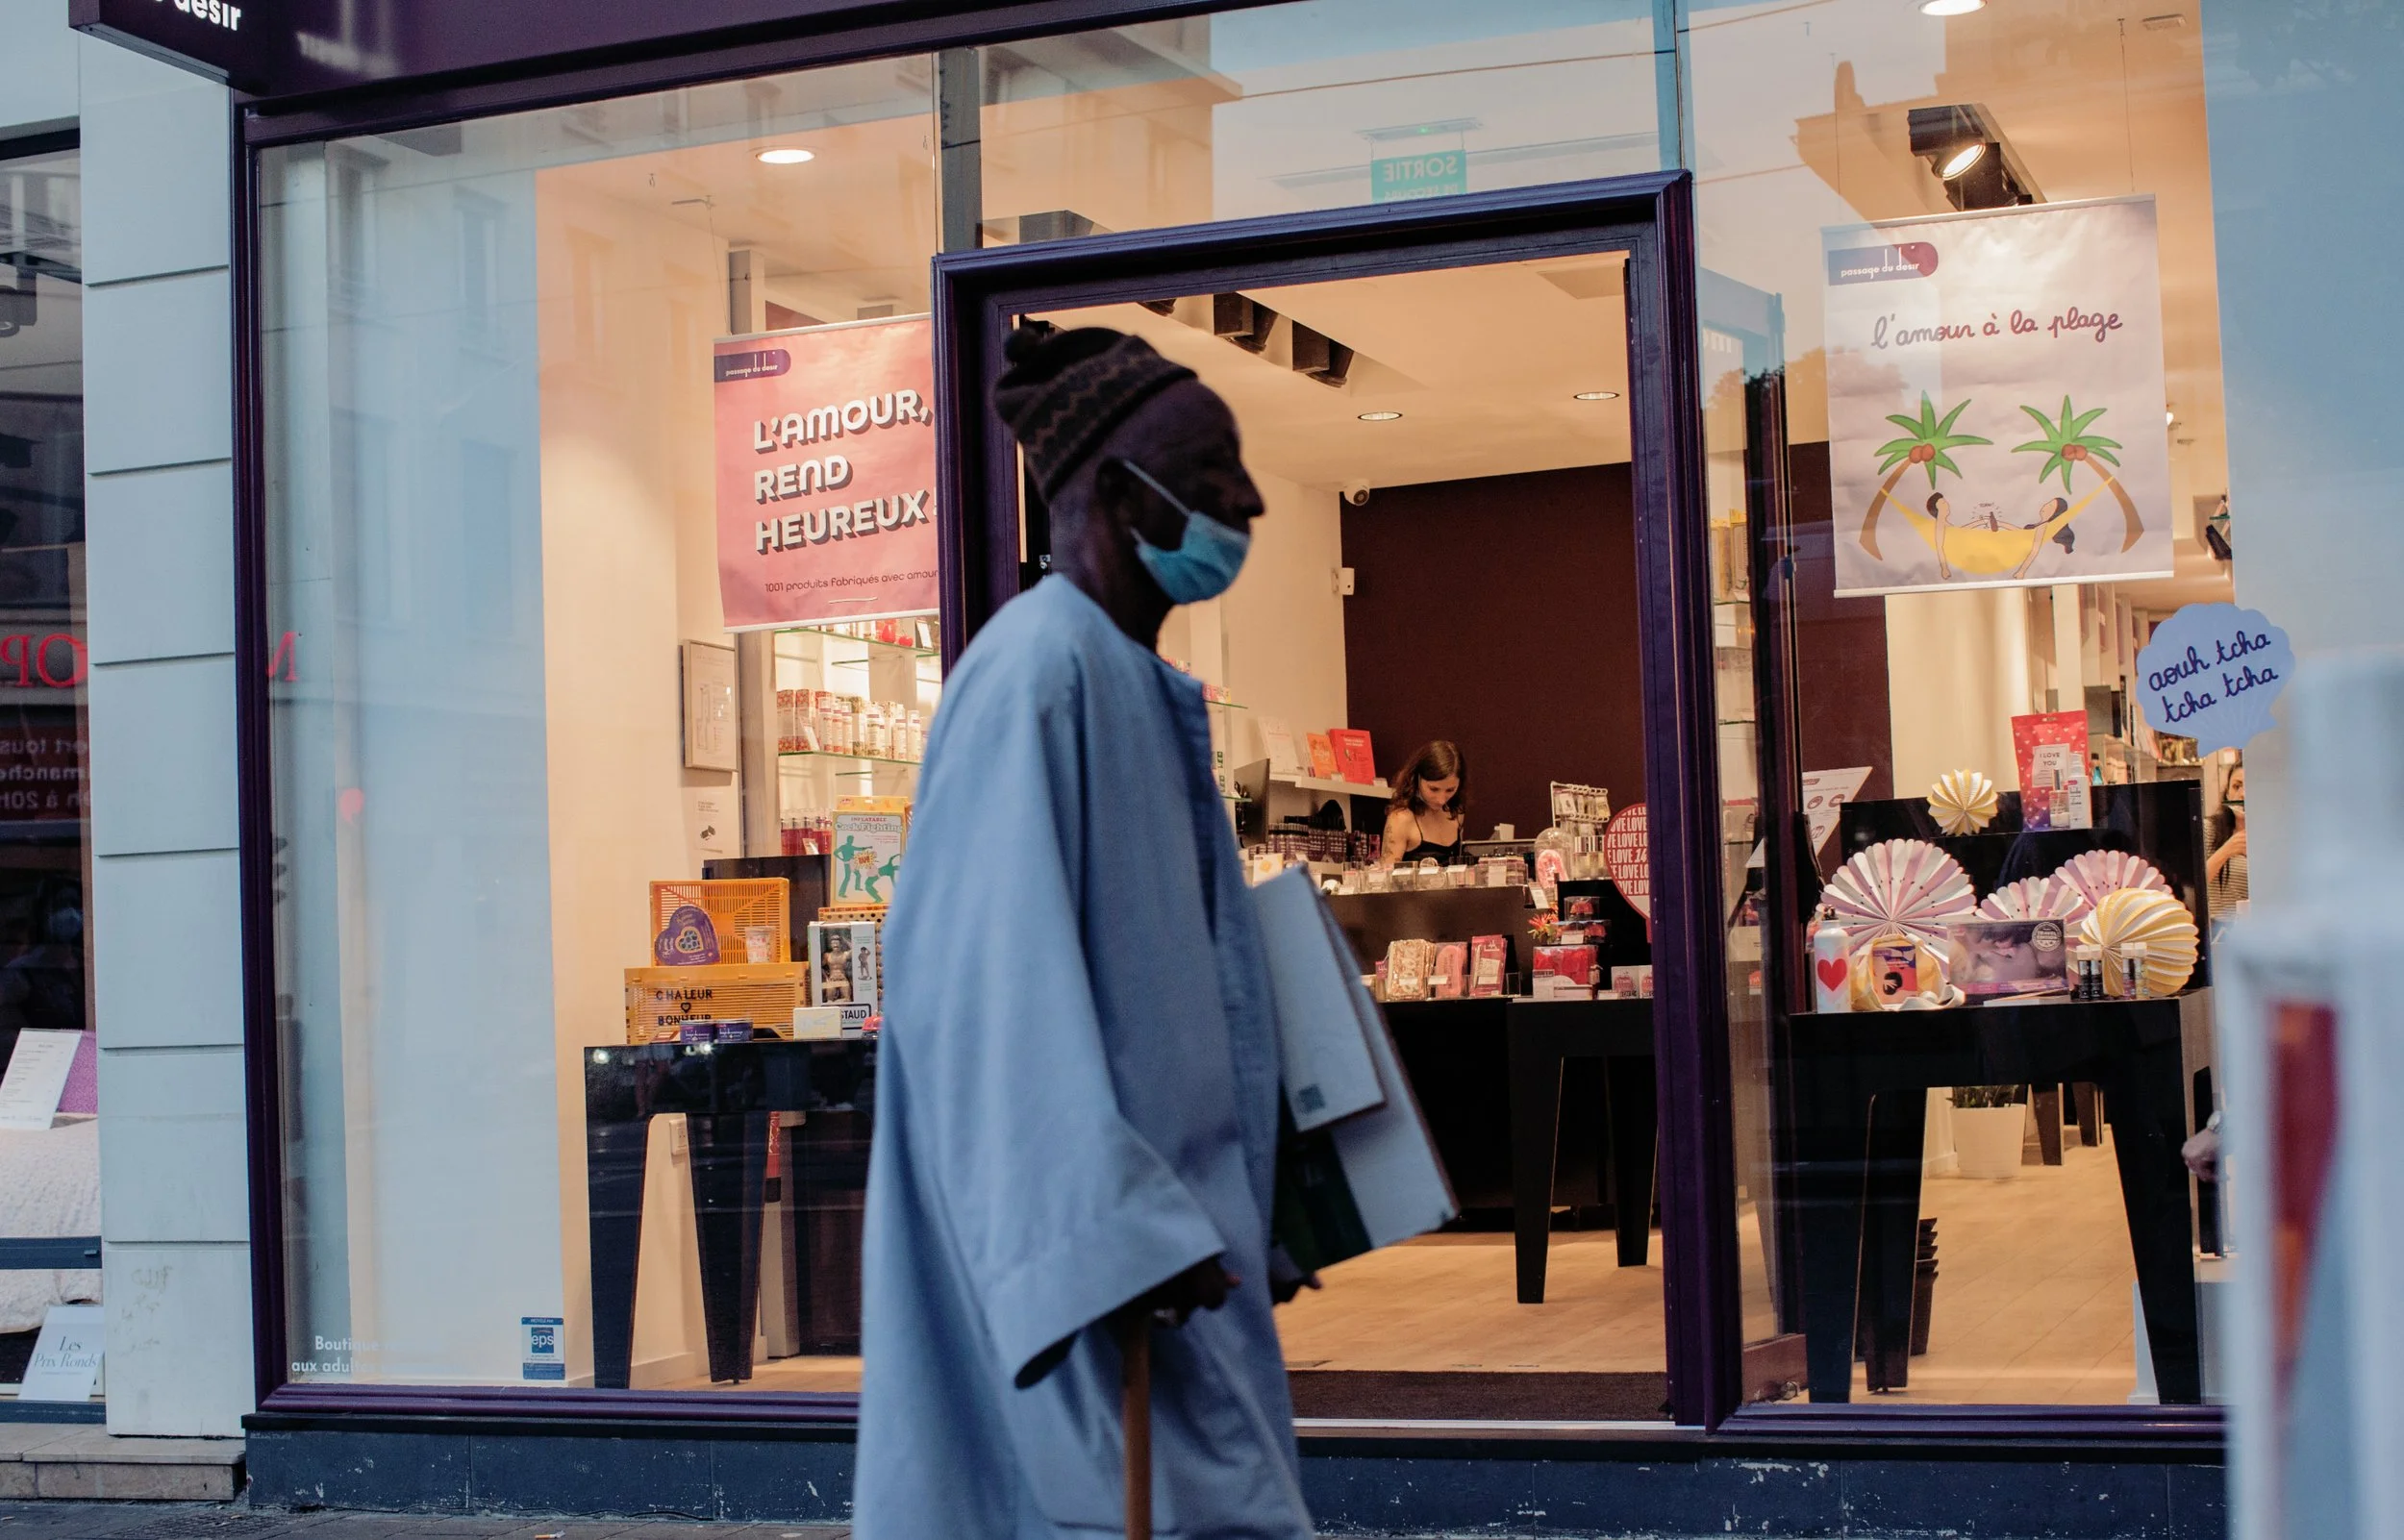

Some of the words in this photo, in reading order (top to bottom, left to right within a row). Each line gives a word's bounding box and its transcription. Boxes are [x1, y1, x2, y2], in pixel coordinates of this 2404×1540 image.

[1841, 266, 1880, 279] passage
[1882, 248, 1892, 272] du
[1871, 313, 1974, 349] l'amour
[1983, 313, 2000, 336] à
[2011, 310, 2039, 334] la
[2047, 307, 2123, 342] plage
[754, 389, 933, 453] L'AMOUR,
[755, 455, 853, 505] REND
[756, 489, 930, 555] HEUREUX
[764, 583, 784, 592] 1001
[787, 580, 828, 592] produits
[831, 574, 879, 587] fabriqués
[882, 573, 905, 583] avec
[907, 570, 939, 580] amour
[2149, 646, 2210, 691] aouh
[2216, 631, 2270, 664] tcha
[2162, 691, 2216, 723] tcha
[2222, 666, 2278, 698] tcha
[1617, 832, 1638, 848] LOVE
[1613, 849, 1633, 863] LOVE
[1618, 864, 1639, 880] LOVE
[656, 988, 713, 1000] CHALEUR
[532, 1334, 554, 1348] eps
[291, 1361, 317, 1373] aux
